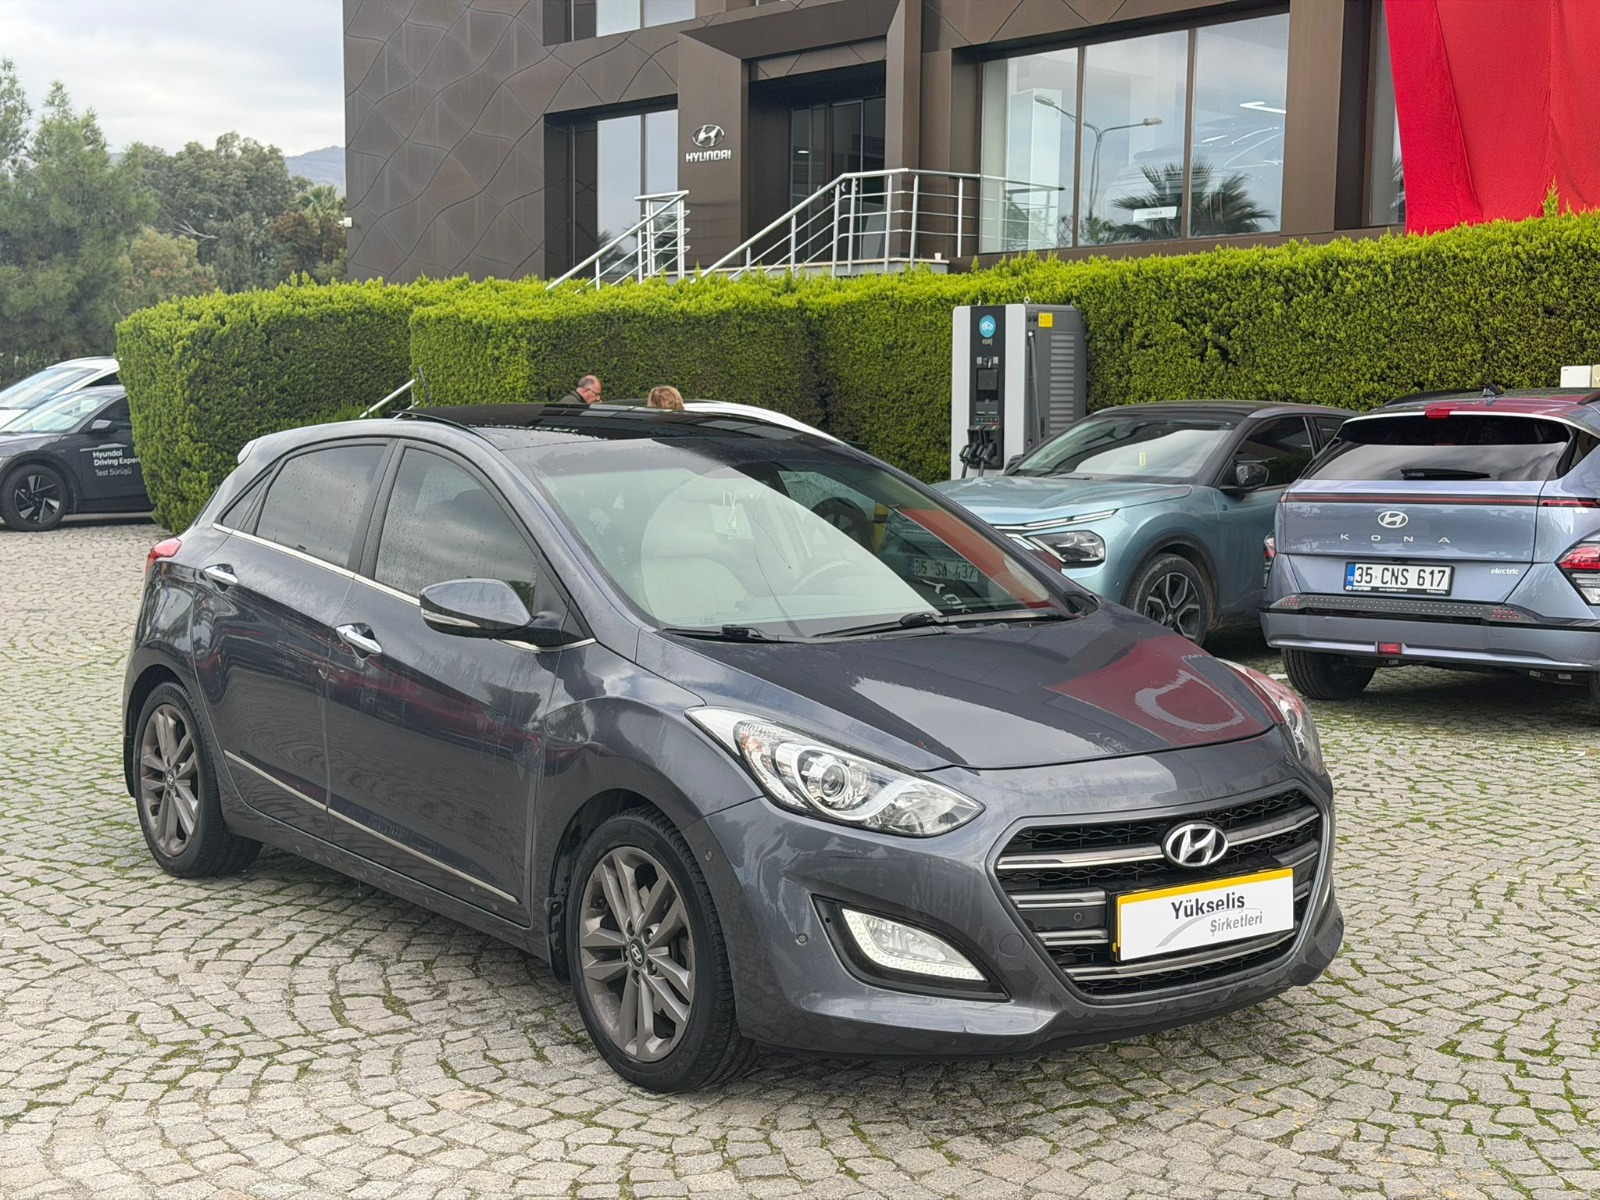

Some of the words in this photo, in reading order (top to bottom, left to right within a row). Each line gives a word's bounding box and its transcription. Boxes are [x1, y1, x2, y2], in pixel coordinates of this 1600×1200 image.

[686, 149, 731, 162] HYUNDAI
[92, 449, 123, 459] Hyundai
[94, 458, 119, 467] Driving
[95, 469, 109, 477] Test
[1490, 567, 1519, 575] electric
[1355, 566, 1373, 584] 35
[1381, 567, 1409, 586] CNS
[1417, 569, 1446, 588] 617
[1170, 892, 1246, 920] Yükseliş
[1209, 911, 1263, 936] Şirketleri
